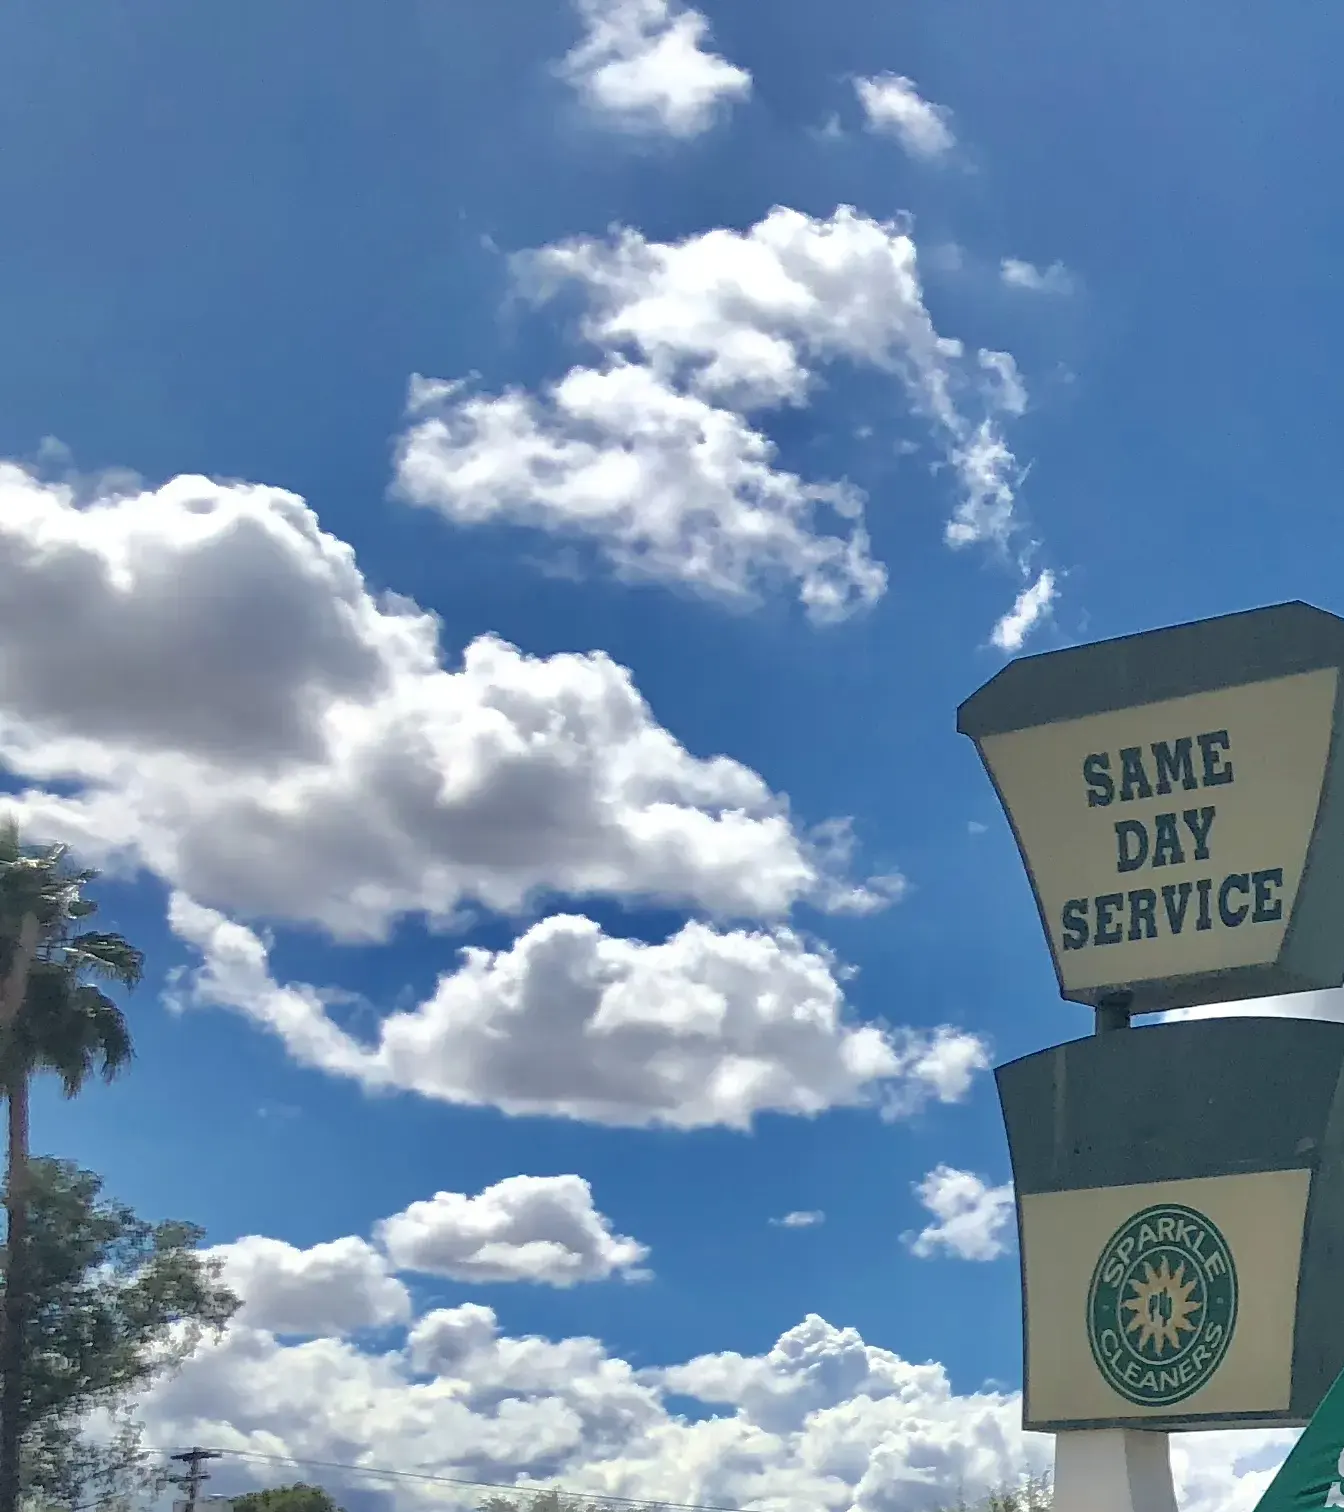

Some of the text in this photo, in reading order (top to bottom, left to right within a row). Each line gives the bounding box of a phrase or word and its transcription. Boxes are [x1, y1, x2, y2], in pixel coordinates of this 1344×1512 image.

[1083, 730, 1234, 807] SAME
[1114, 805, 1216, 873] DAY
[1062, 868, 1283, 950] SERVICE
[1103, 1217, 1227, 1288] SPARKLE
[1100, 1321, 1224, 1392] CLEANERS
